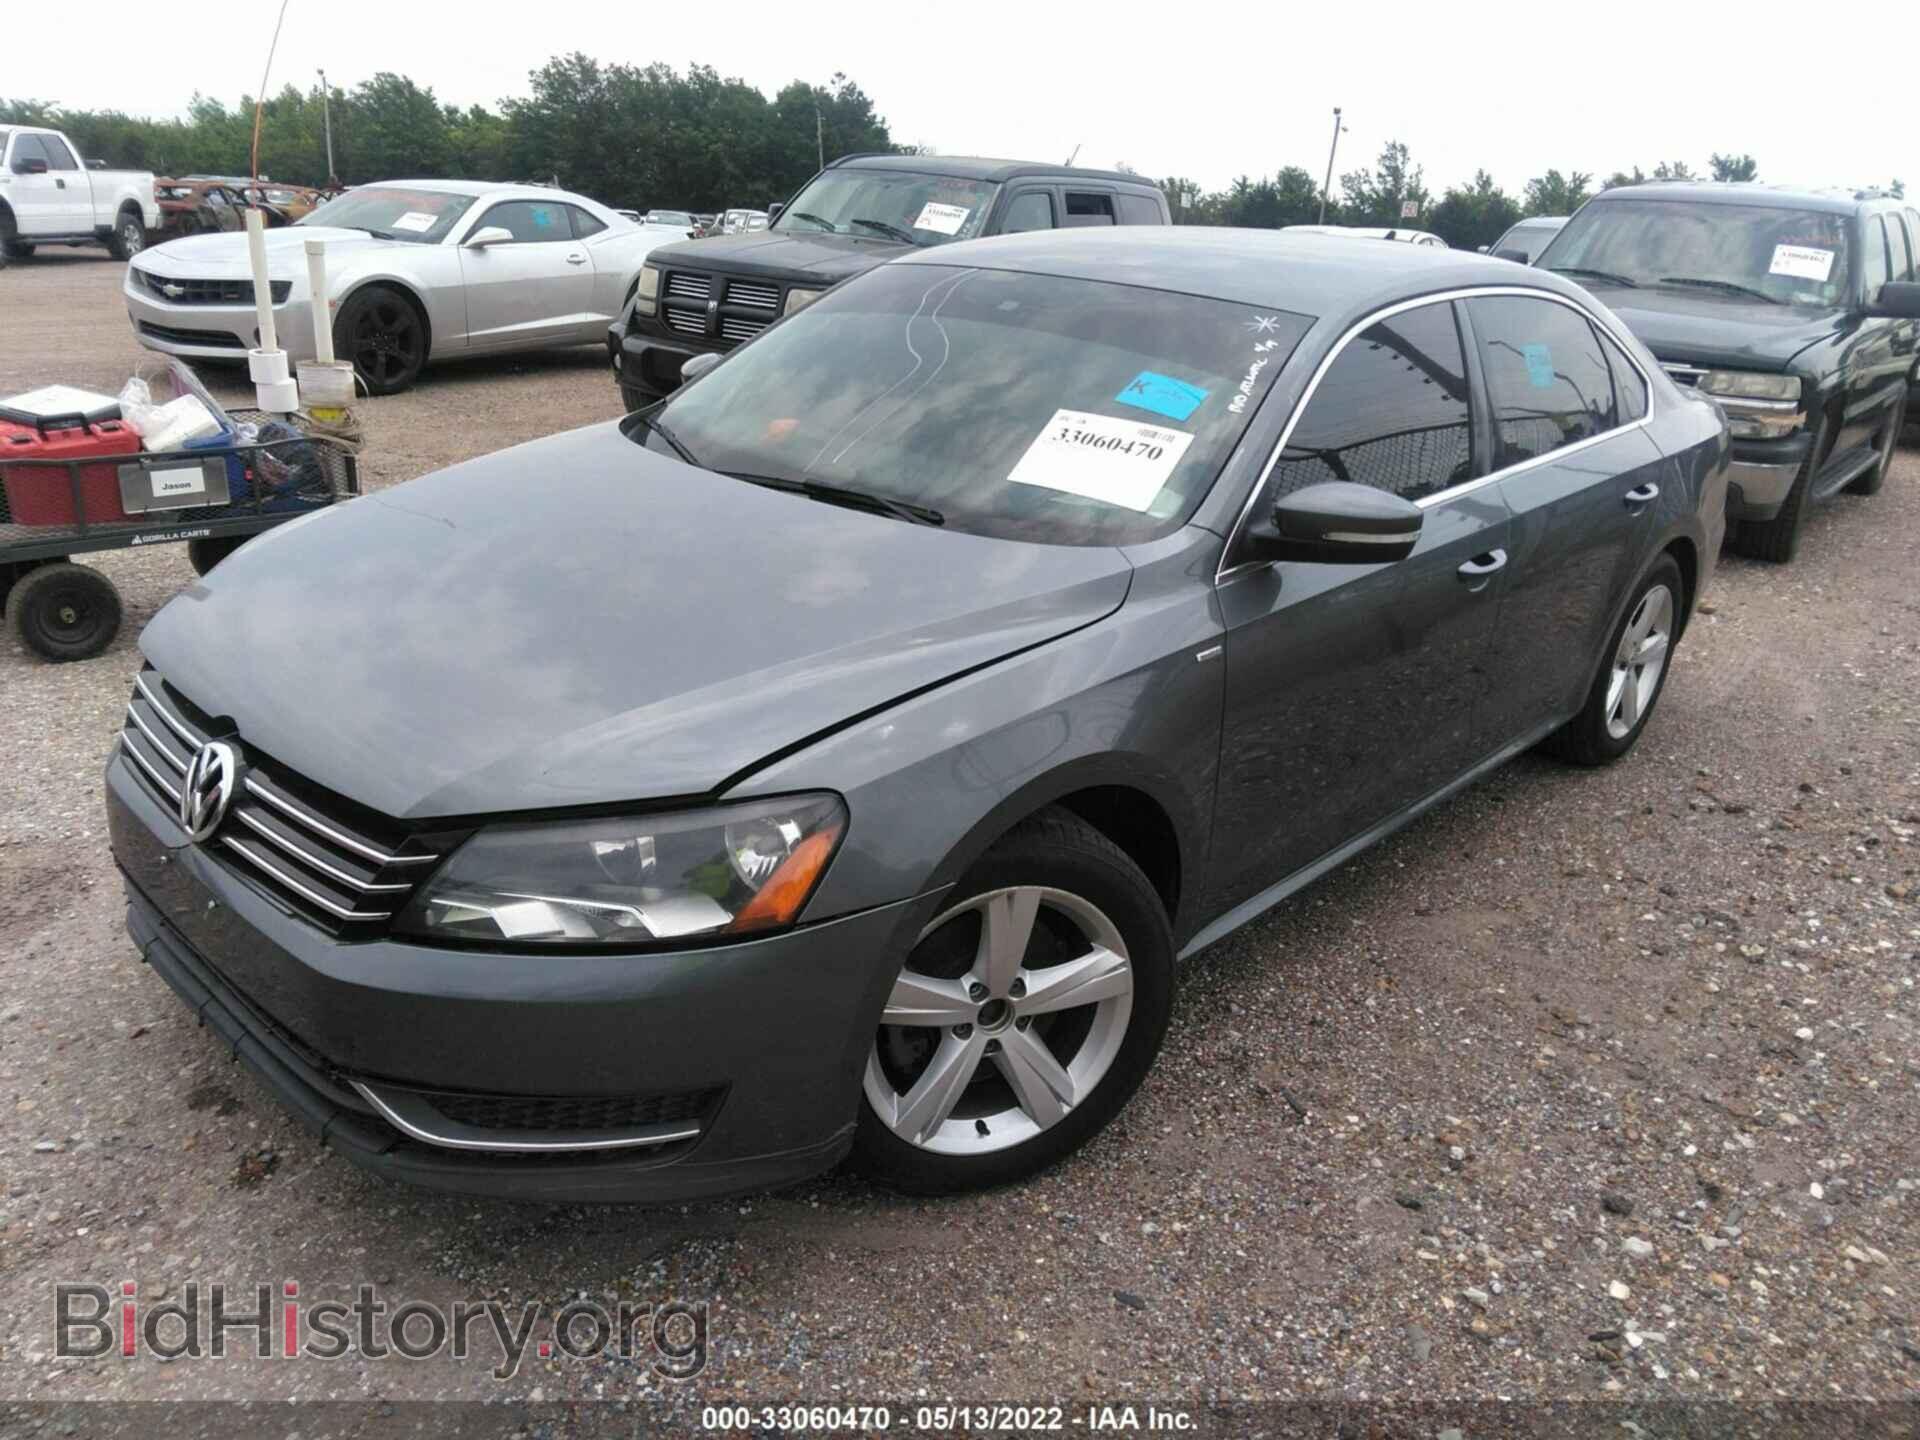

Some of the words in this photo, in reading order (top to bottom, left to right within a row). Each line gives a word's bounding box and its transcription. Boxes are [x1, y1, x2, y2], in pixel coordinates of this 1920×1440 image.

[1052, 427, 1163, 461] 33060470
[162, 481, 192, 490] Jason
[142, 533, 179, 542] GORILLA
[180, 529, 210, 539] CARTS
